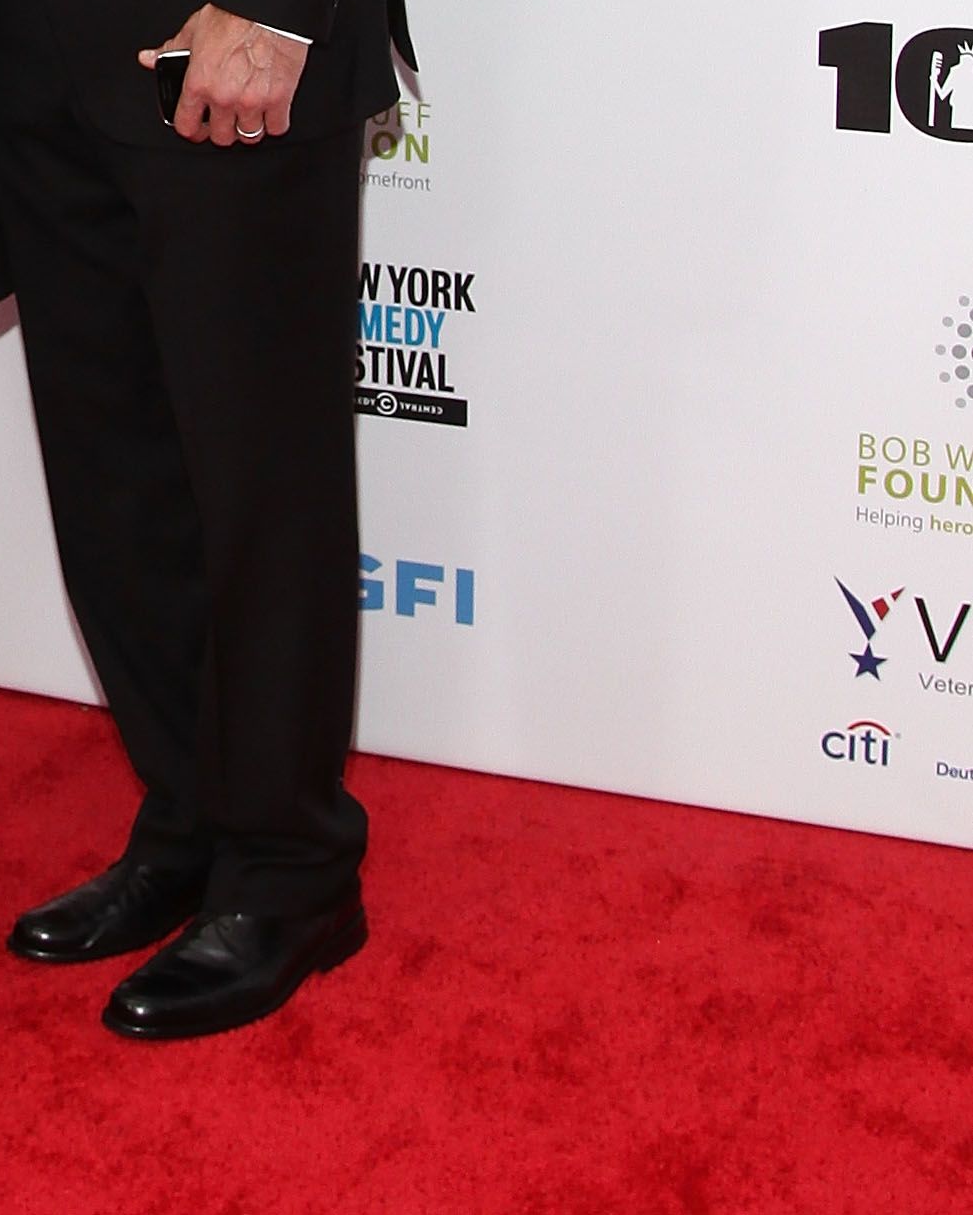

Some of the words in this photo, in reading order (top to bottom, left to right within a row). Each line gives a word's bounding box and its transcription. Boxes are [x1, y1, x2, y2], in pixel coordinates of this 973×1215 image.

[371, 130, 429, 163] ON
[387, 265, 476, 313] YORK
[858, 433, 931, 466] BOB
[856, 506, 924, 534] Helping
[821, 729, 890, 766] citi
